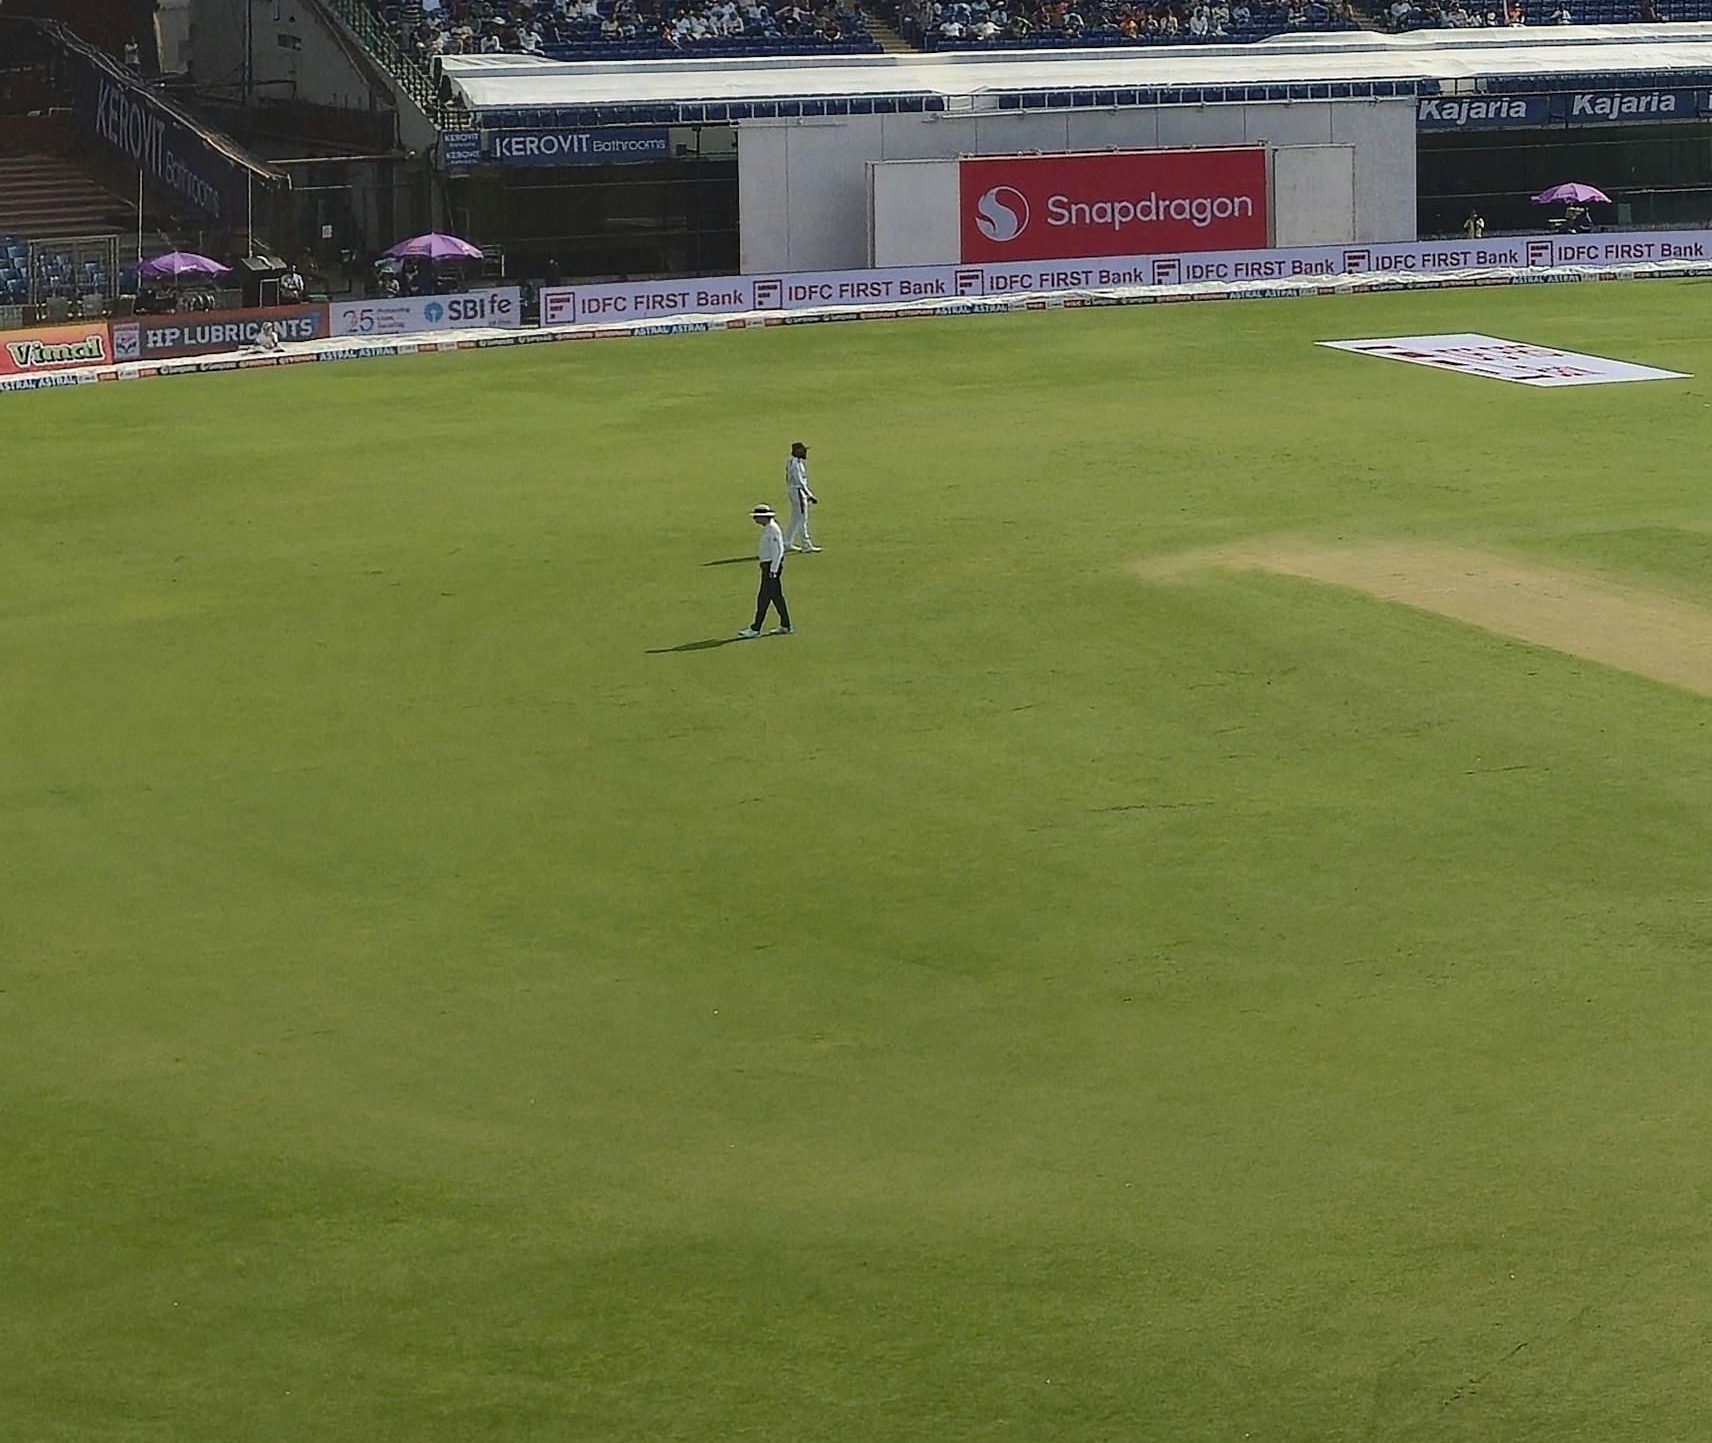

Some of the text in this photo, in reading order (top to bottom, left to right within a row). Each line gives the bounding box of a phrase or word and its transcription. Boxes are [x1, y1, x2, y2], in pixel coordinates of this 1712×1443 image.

[1418, 97, 1527, 126] Kajaria
[1572, 93, 1675, 120] Kajaria
[494, 134, 590, 157] KEROVIT
[593, 138, 665, 152] Bathrooms
[1046, 192, 1253, 230] Snapdragon
[1375, 247, 1519, 271] IDFC FIRST Bank
[1558, 238, 1704, 261] IDFC FIRST Bank
[990, 267, 1143, 290] IDFC FIRST Bank
[1186, 257, 1334, 281] IDFC FIRST Bank
[788, 278, 945, 301] IDFC FIRST Bank
[448, 298, 485, 320] SBI
[581, 289, 743, 315] IDFC FIRST Bank
[146, 328, 180, 348] HP
[7, 335, 103, 367] Vimal
